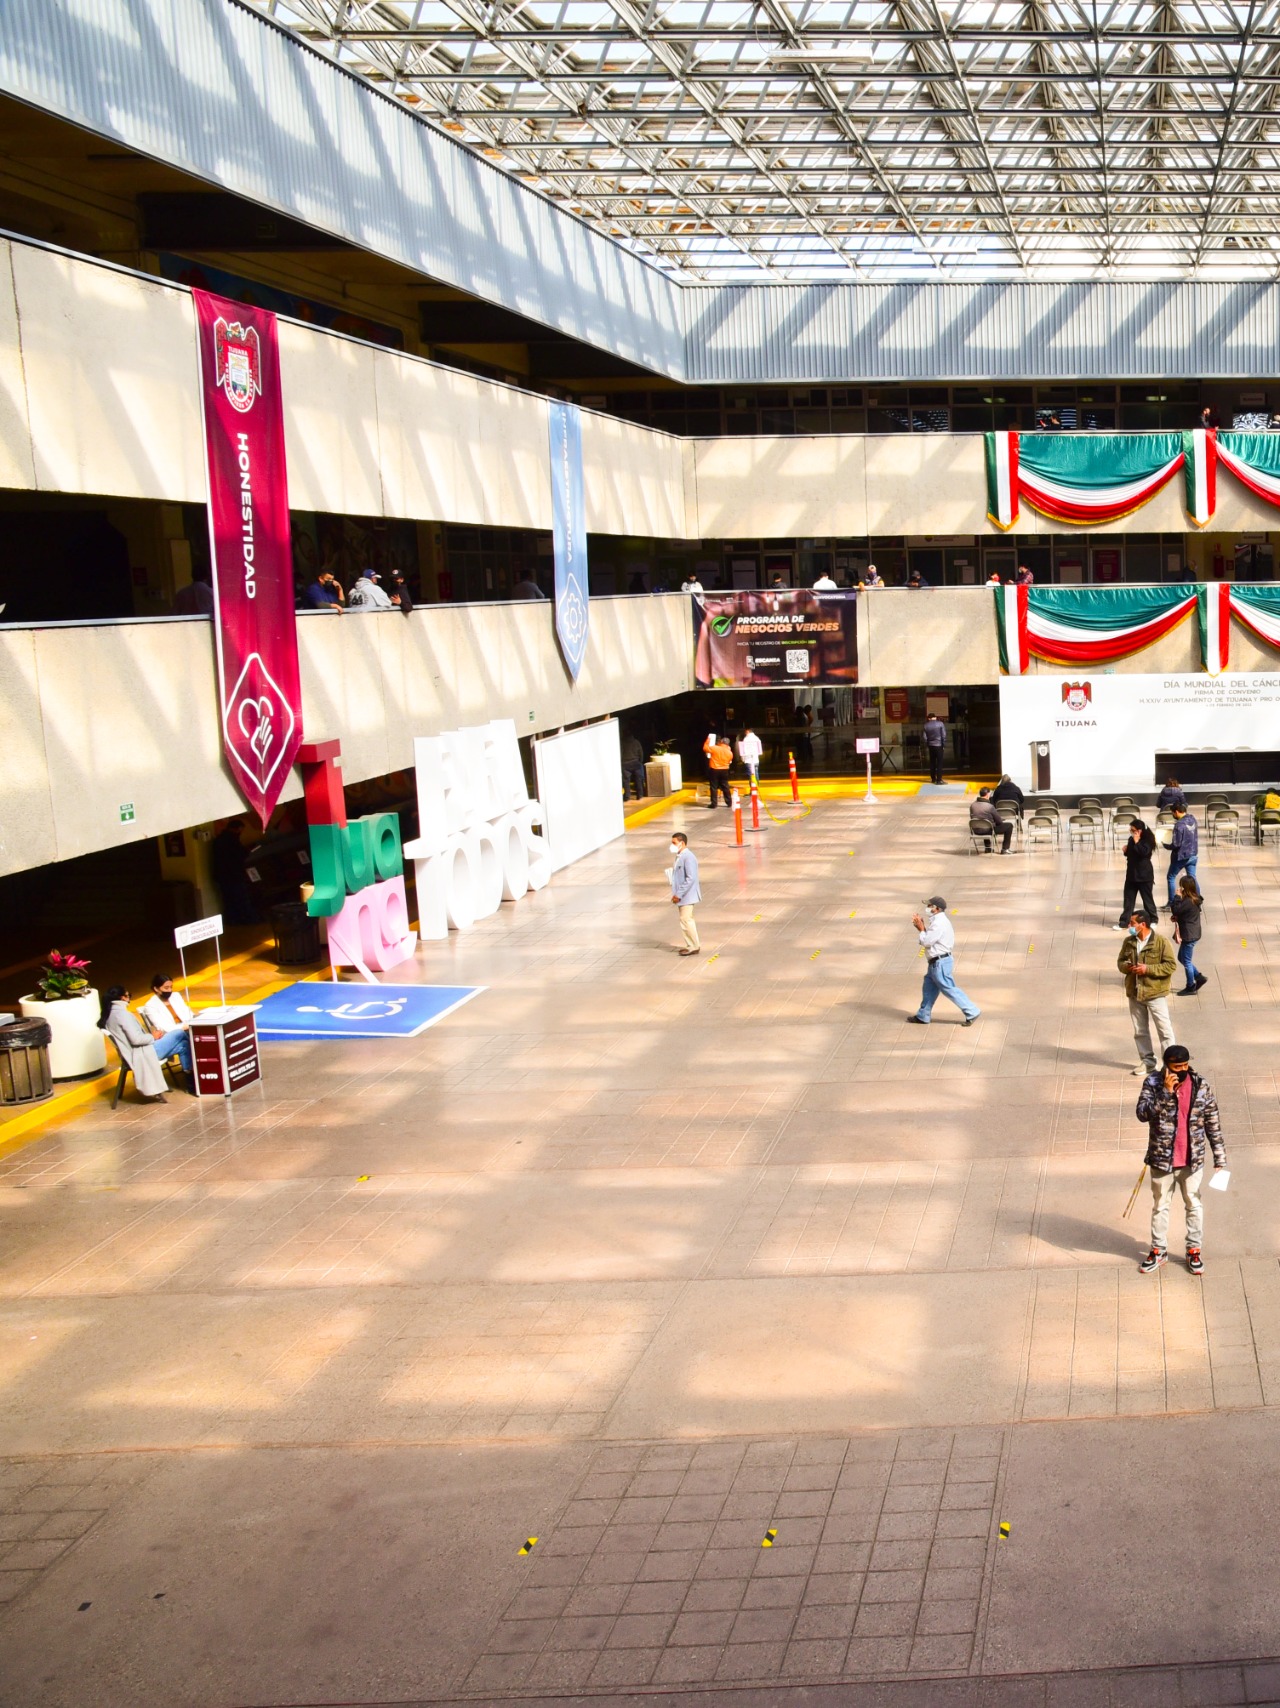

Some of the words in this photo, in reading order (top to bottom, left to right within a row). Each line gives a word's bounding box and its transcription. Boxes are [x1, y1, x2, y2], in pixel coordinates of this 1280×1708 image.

[236, 432, 257, 600] HONESTIDAD
[736, 615, 790, 625] PROGRAMA
[791, 615, 805, 623] DE
[734, 623, 793, 634] NEGOCIOS
[795, 622, 840, 632] VERDES
[1163, 679, 1181, 689] DÍA
[1184, 680, 1226, 688] MUNDIAL
[1230, 680, 1249, 688] DEL
